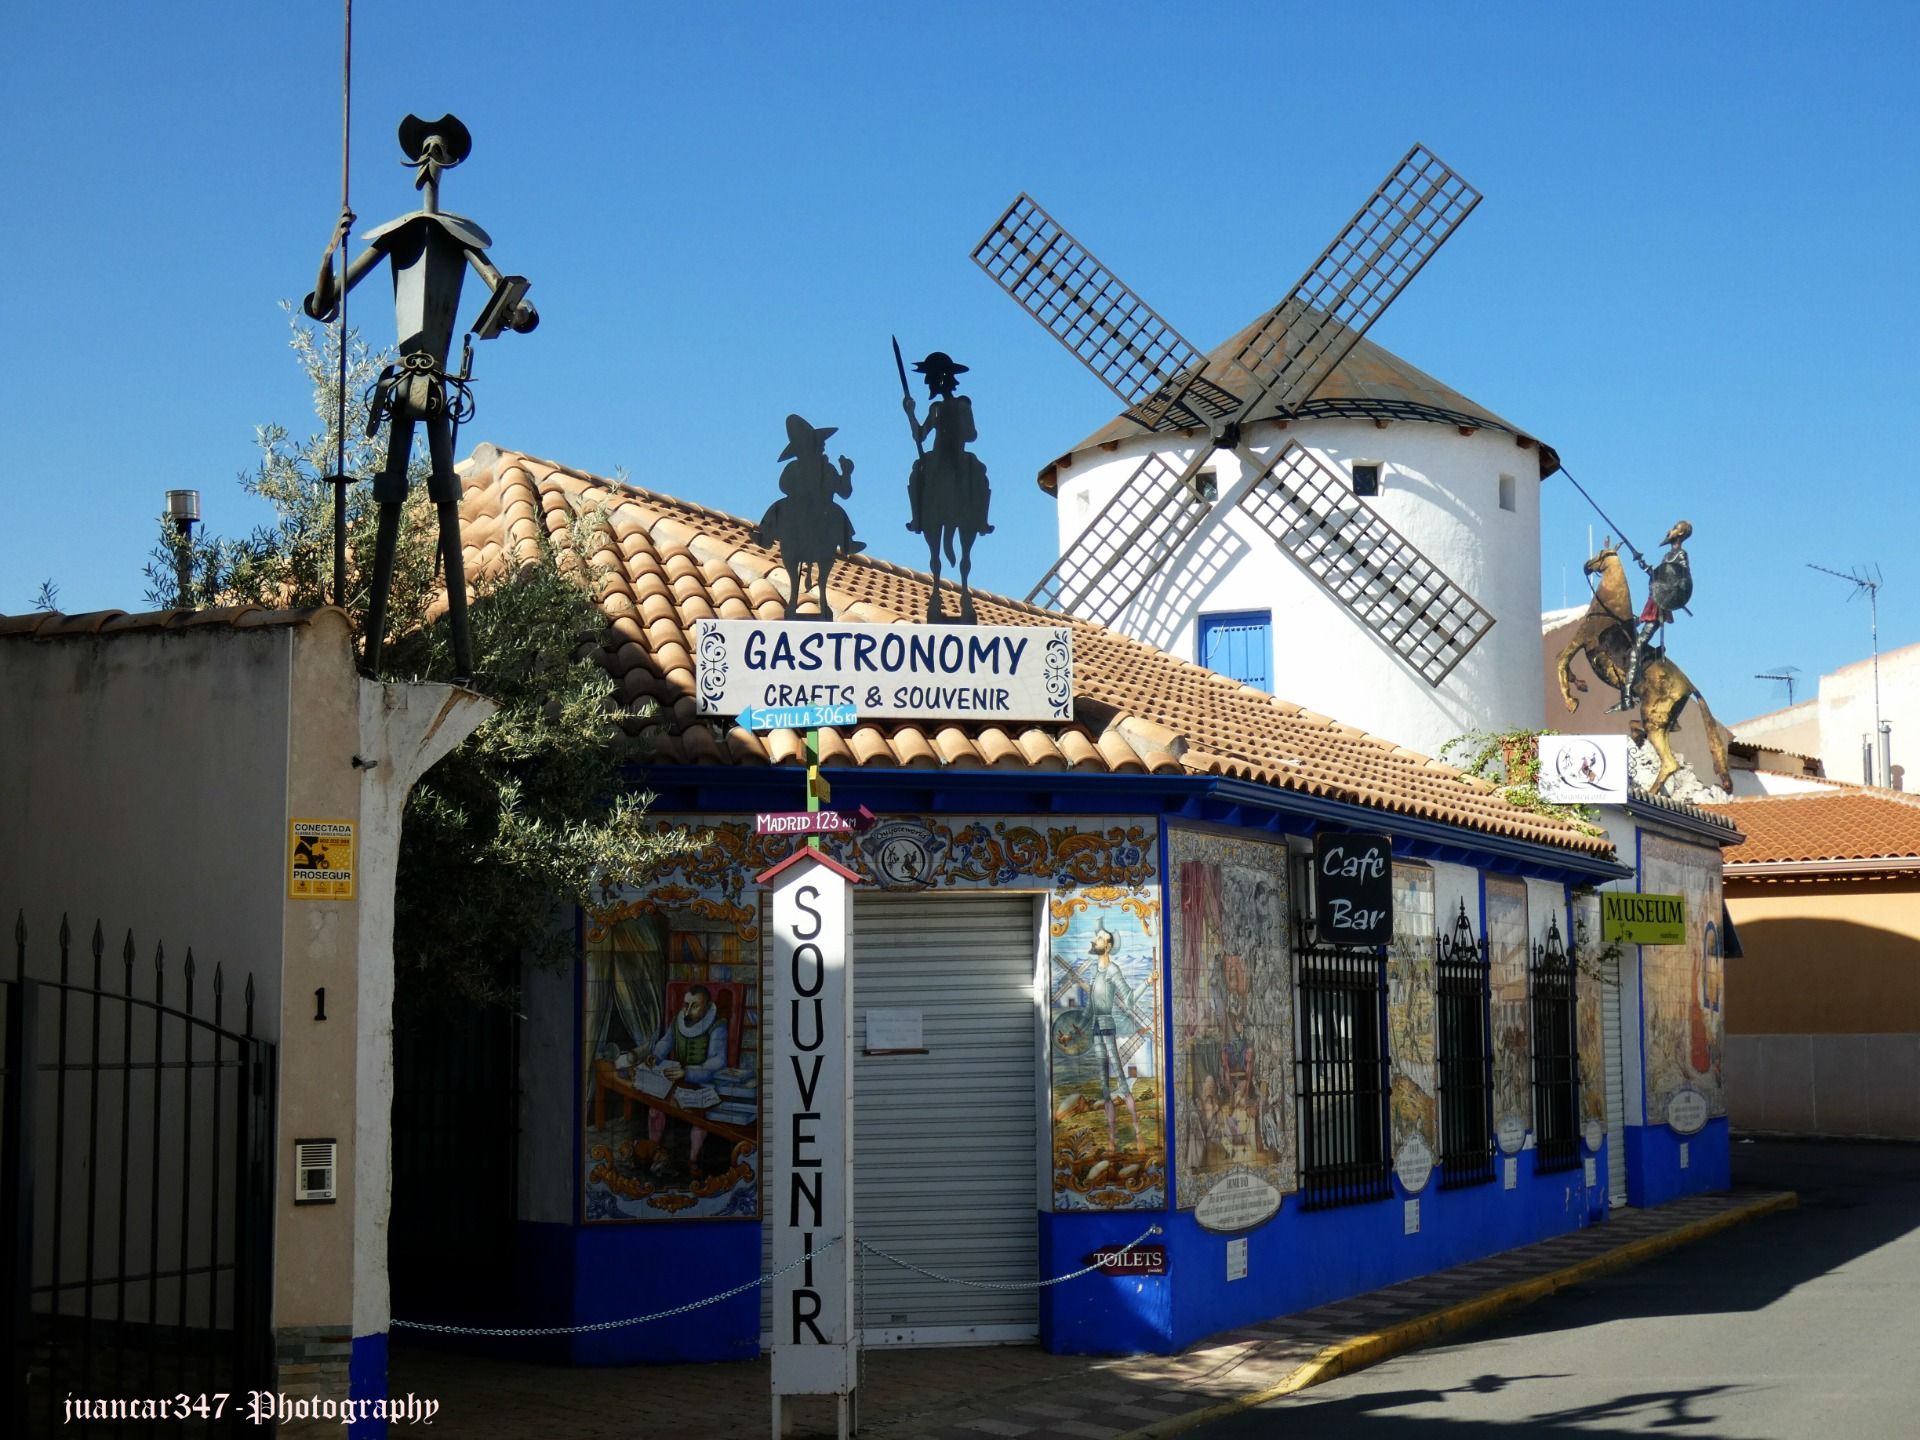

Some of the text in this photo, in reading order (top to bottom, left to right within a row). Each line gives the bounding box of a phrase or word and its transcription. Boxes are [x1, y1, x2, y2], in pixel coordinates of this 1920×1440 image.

[743, 630, 1028, 676] GASTRONOMY
[764, 684, 1010, 711] CRAFTS & SOUVENIR
[812, 706, 845, 725] 306
[294, 823, 352, 833] CONECTADA
[757, 814, 811, 833] MADRID
[815, 812, 839, 830] 123
[293, 870, 352, 880] PROSEGUR
[1328, 898, 1386, 930] Bar
[1606, 897, 1683, 924] MUSEUM
[313, 986, 327, 1021] 1
[788, 885, 832, 1345] SOUVENIR
[1093, 1251, 1163, 1267] TOILETS
